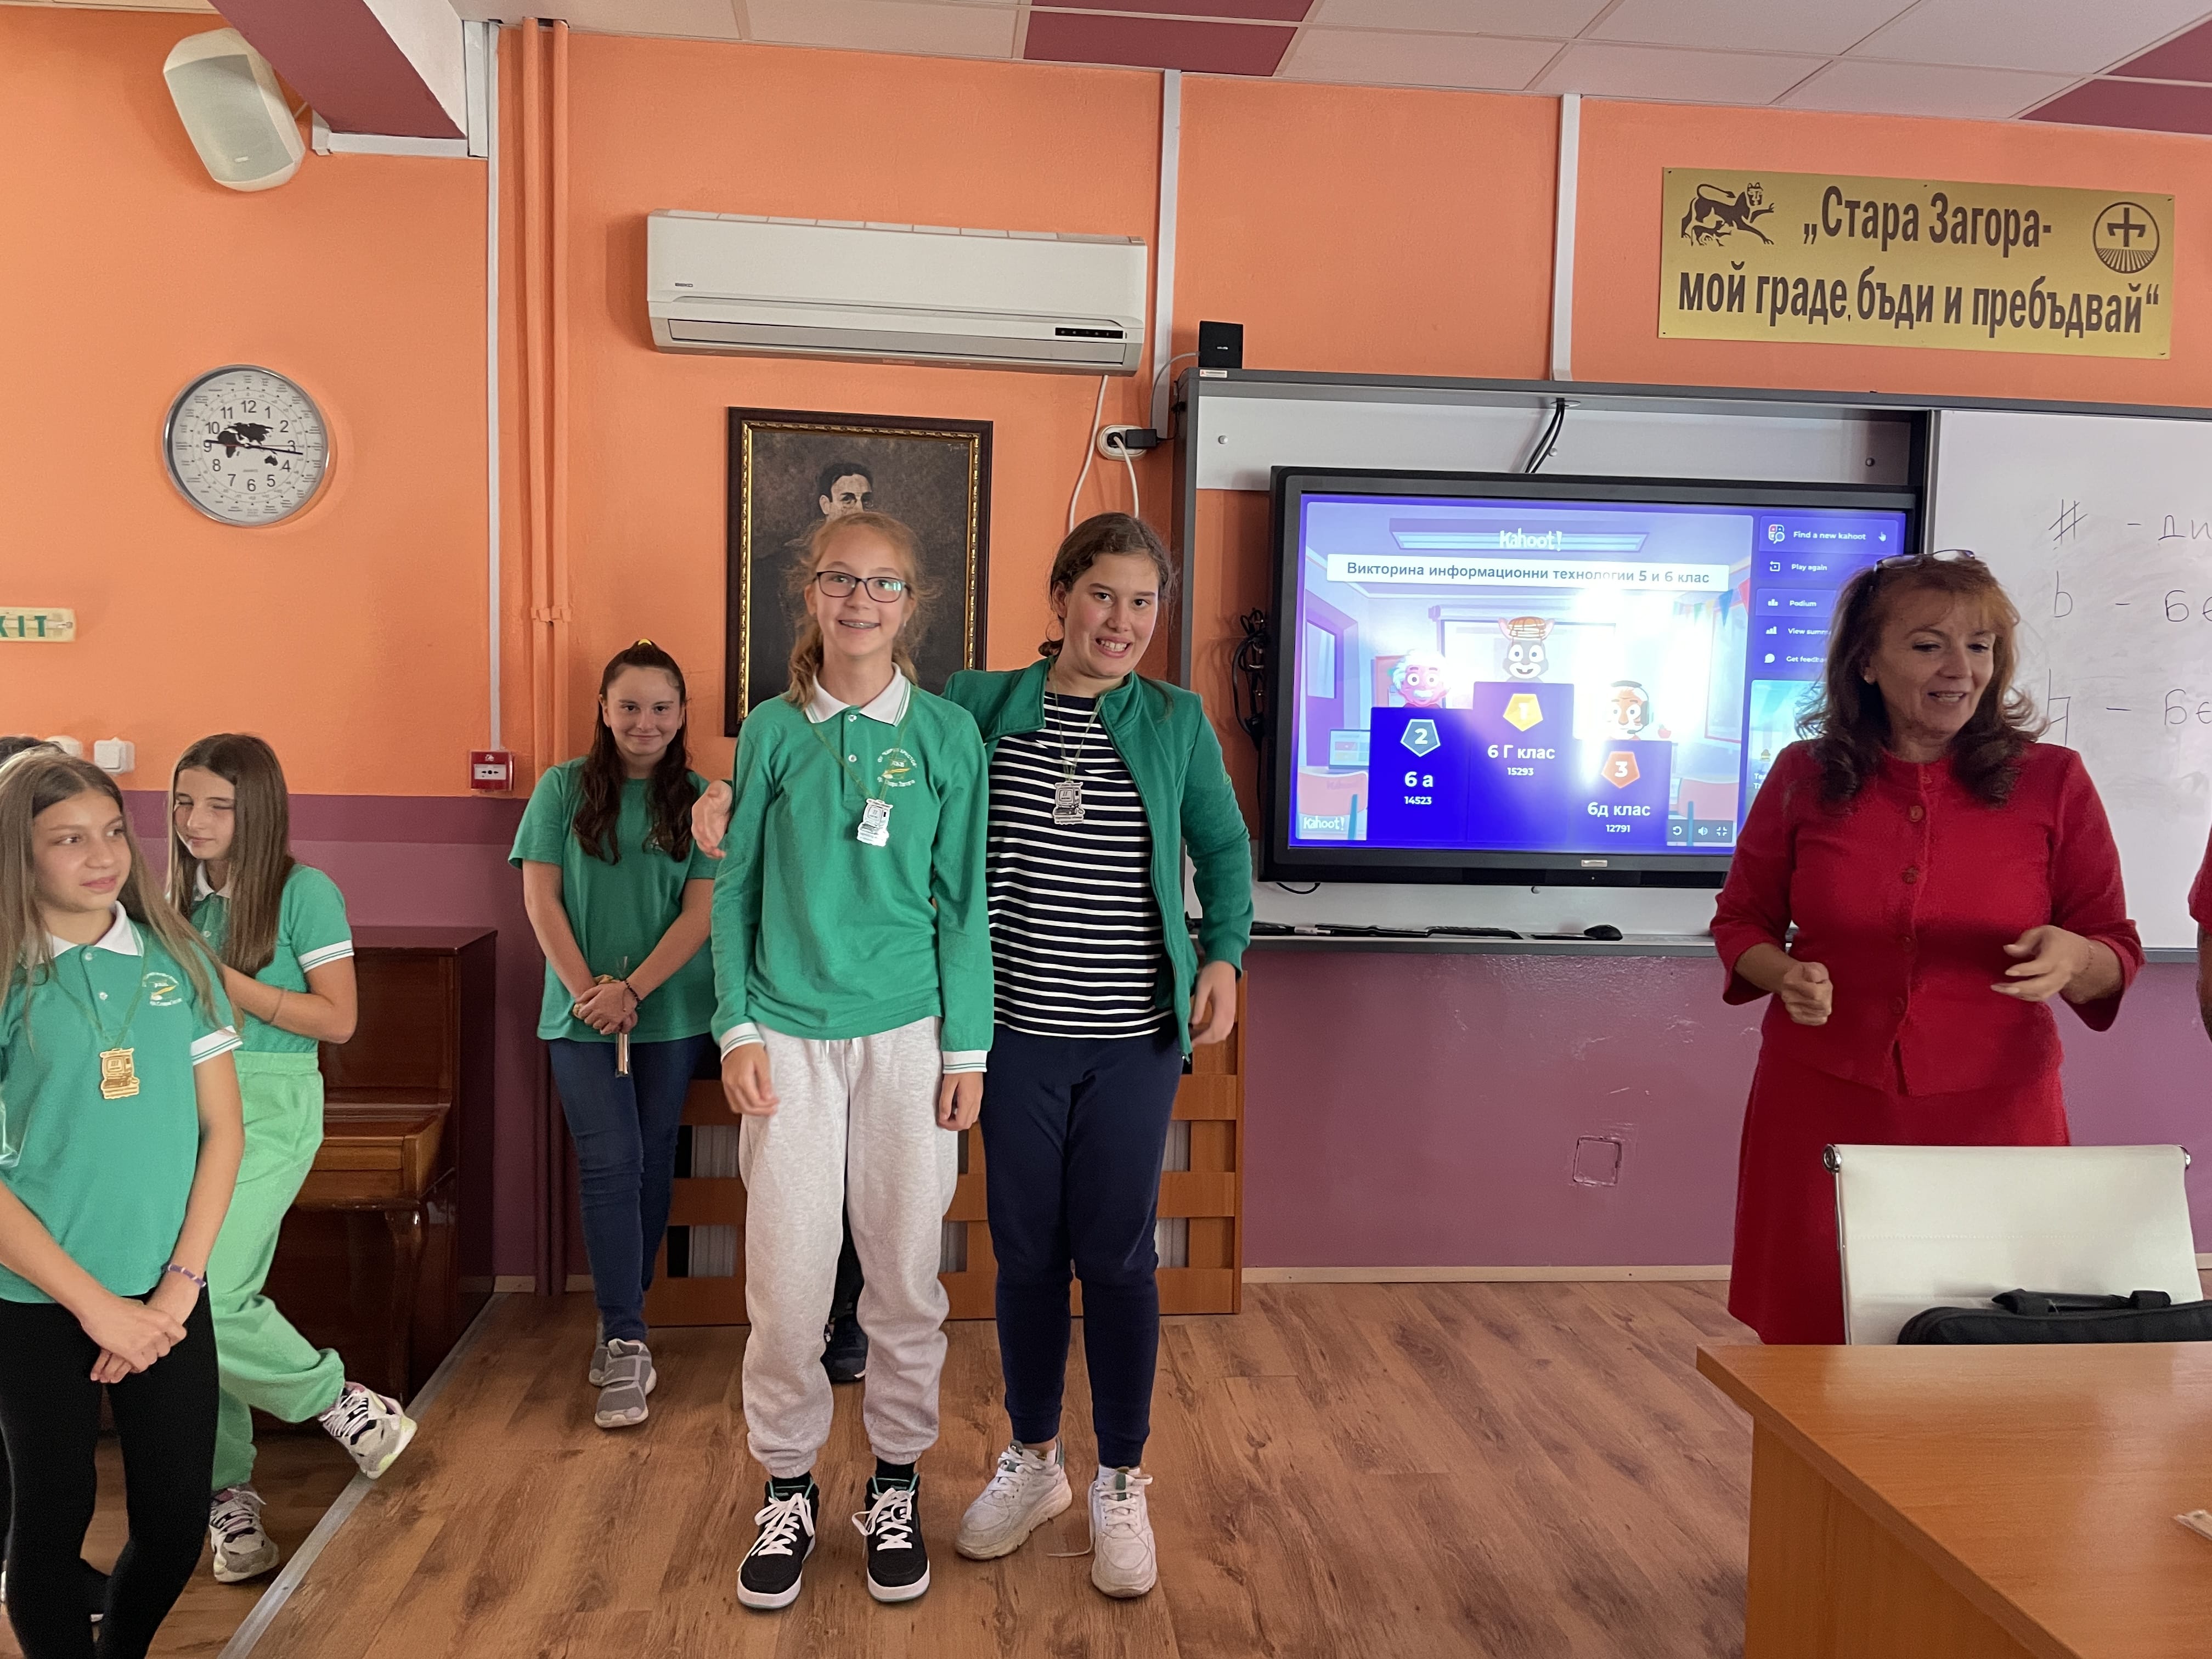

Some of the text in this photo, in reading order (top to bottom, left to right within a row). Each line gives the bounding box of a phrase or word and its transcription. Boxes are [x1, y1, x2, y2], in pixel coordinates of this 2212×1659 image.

[1804, 185, 2052, 258] „Стара Загора-
[1679, 261, 1746, 313] мой
[1857, 266, 1934, 330] бъди
[1944, 286, 1962, 324] и
[1972, 275, 2159, 338] пребъдвай“
[221, 407, 233, 419] 11
[241, 400, 257, 413] 12
[265, 407, 270, 419] 1
[205, 421, 220, 435] 10
[280, 420, 289, 432] 2
[213, 459, 221, 472] 8
[280, 460, 291, 472] 4
[228, 473, 236, 487] 7
[247, 478, 256, 492] 6
[267, 474, 275, 487] 5
[1499, 528, 1562, 552] Kahoot!
[1347, 562, 1424, 578] Викторина
[1429, 565, 1548, 579] информационни
[1639, 570, 1647, 582] 5
[1652, 573, 1660, 582] и
[1664, 571, 1673, 583] 6
[1678, 574, 1709, 583] клас
[1519, 702, 1528, 720] 1
[1414, 728, 1429, 744] 2
[1487, 744, 1555, 759] 6 Г клас
[1507, 768, 1534, 776] 15293
[1615, 761, 1628, 778] 3
[1404, 771, 1417, 787] 6
[1404, 796, 1432, 805] 14523
[1588, 802, 1651, 817] 6д клас
[1303, 816, 1345, 831] Kahoot!
[1606, 825, 1630, 833] 12791
